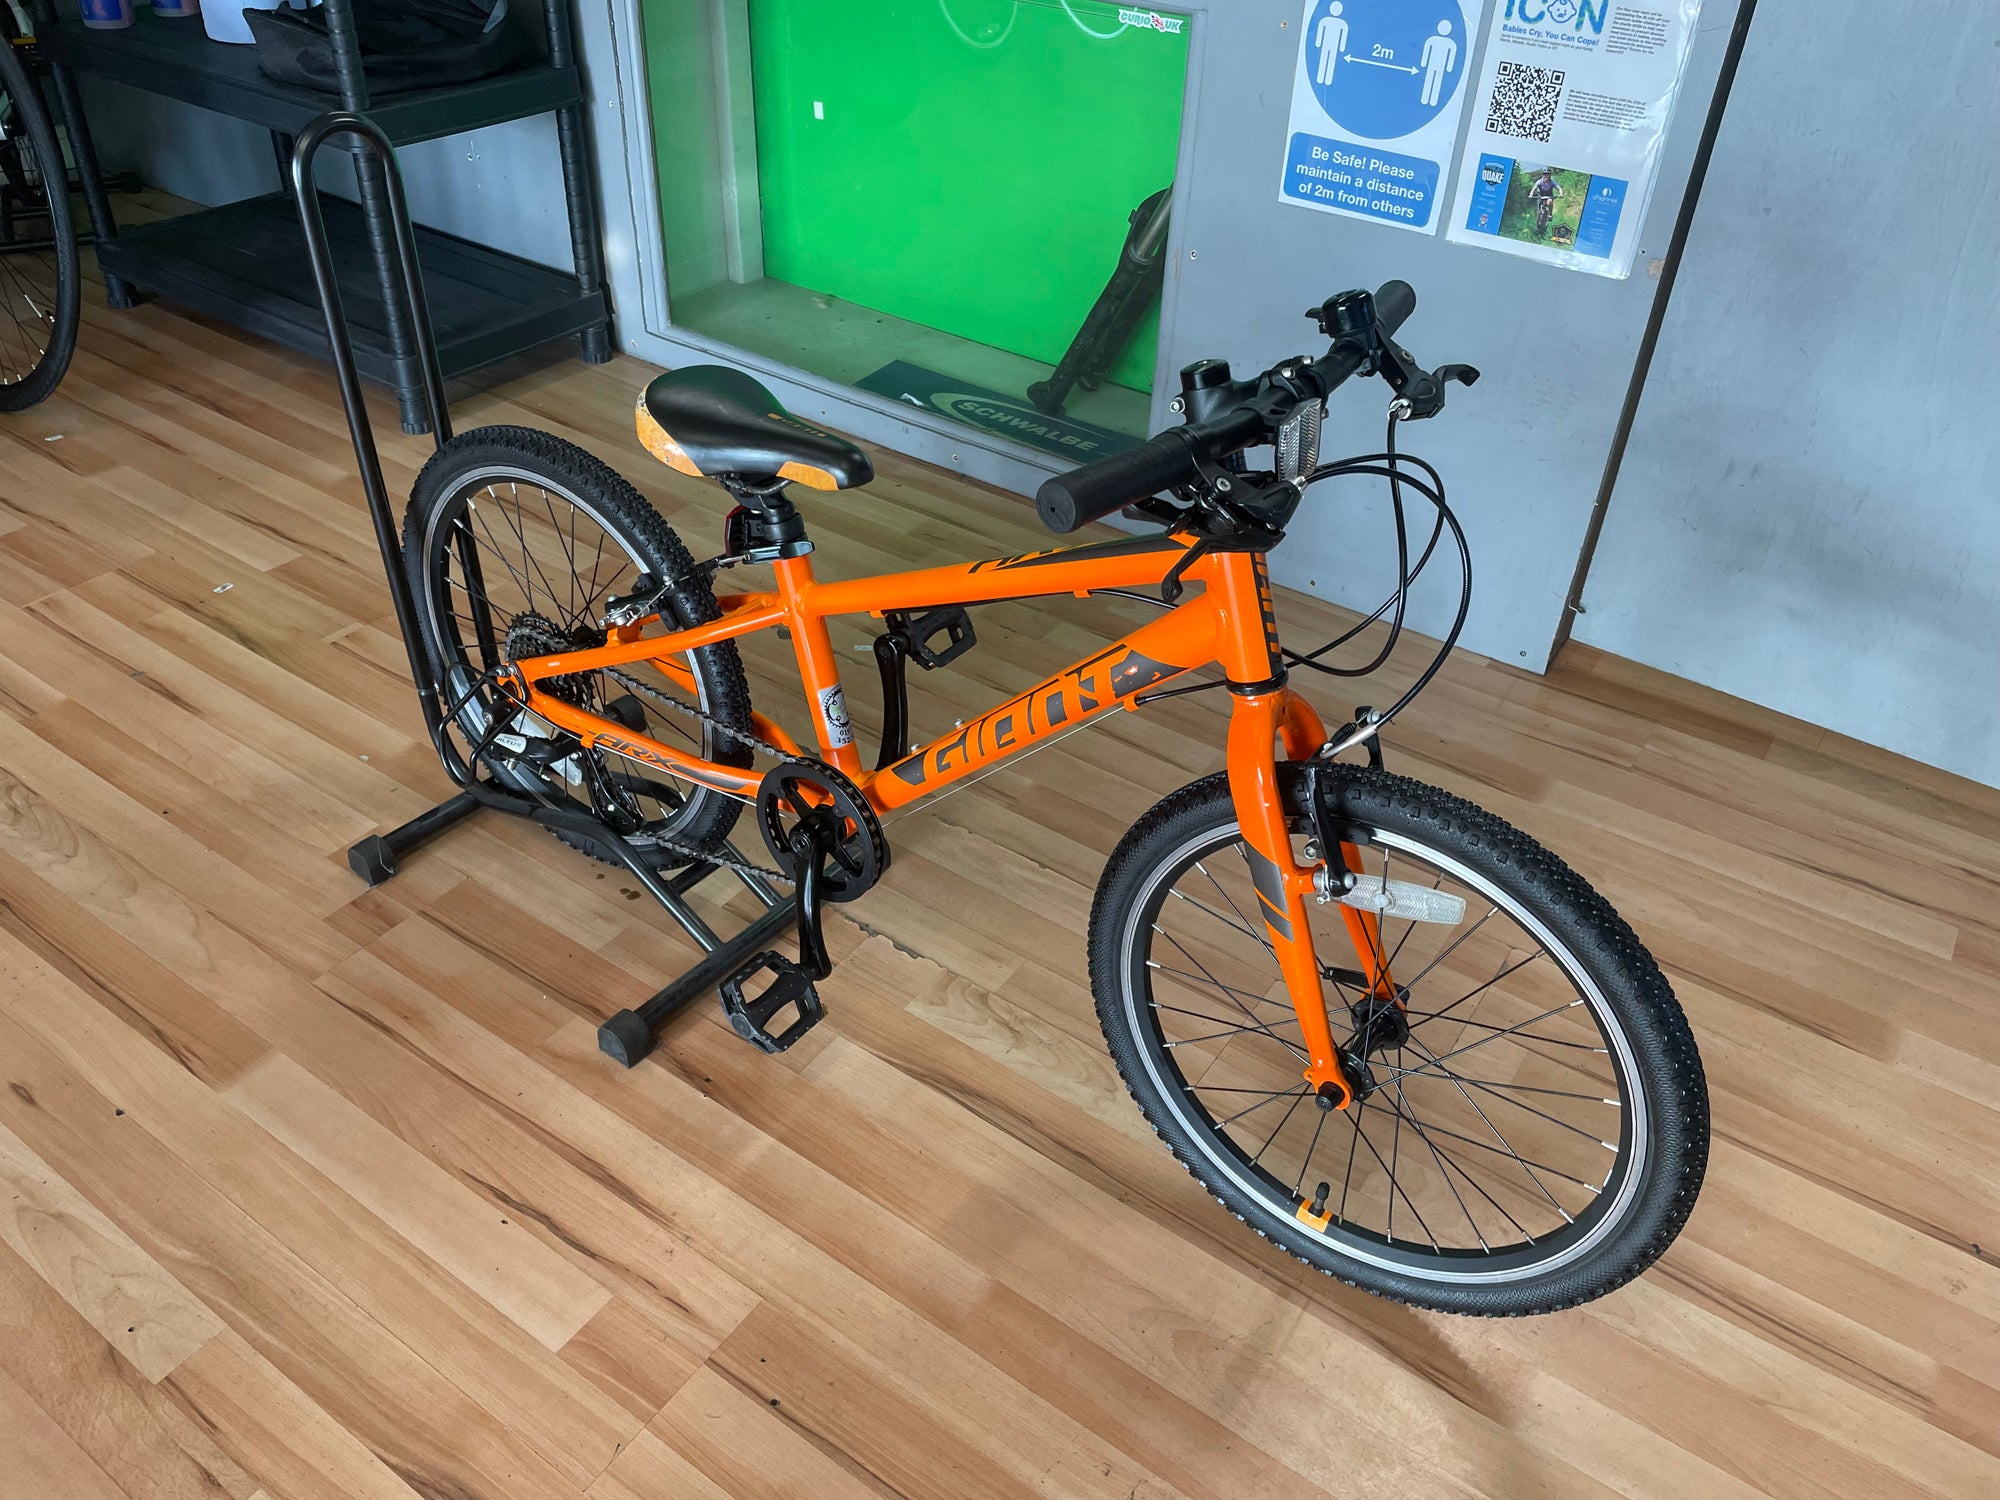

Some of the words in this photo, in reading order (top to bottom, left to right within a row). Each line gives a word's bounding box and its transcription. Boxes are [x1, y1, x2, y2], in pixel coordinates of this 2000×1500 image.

[1164, 20, 1180, 31] UK
[1502, 24, 1527, 34] Babies
[1529, 28, 1543, 38] Cry,
[1545, 31, 1559, 40] You
[1560, 33, 1576, 42] Can
[1576, 36, 1600, 46] Cope!
[1371, 43, 1394, 60] 2m
[1311, 146, 1329, 161] Be
[1332, 150, 1367, 169] Safe!
[1369, 158, 1415, 180] Please
[1482, 170, 1505, 184] QUAKE
[1296, 164, 1351, 185] maintain
[1354, 178, 1363, 188] a
[1366, 178, 1424, 202] distance
[1298, 182, 1312, 194] of
[1314, 184, 1334, 200] 2m
[1337, 189, 1368, 207] from
[1371, 200, 1415, 219] others
[957, 402, 1099, 451] SCHWALBE
[592, 733, 680, 770] ARX
